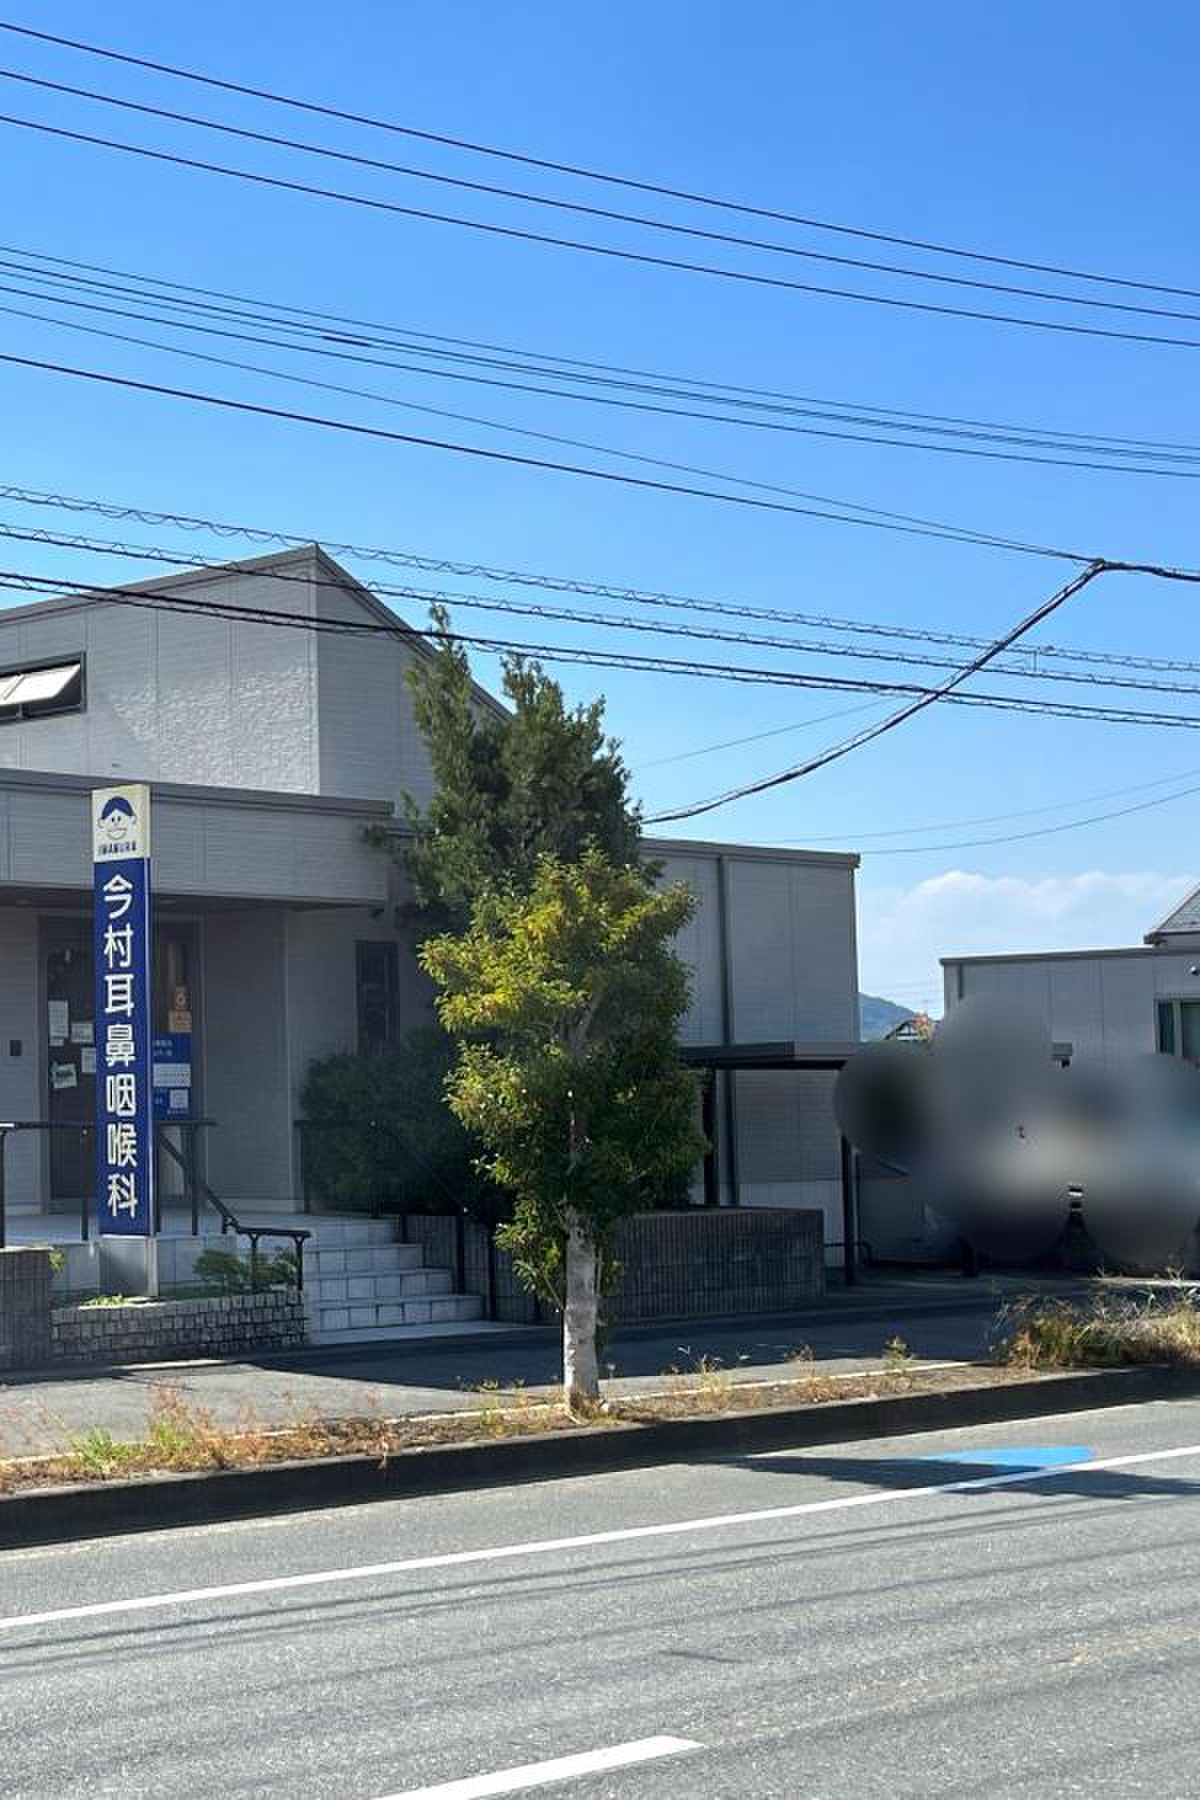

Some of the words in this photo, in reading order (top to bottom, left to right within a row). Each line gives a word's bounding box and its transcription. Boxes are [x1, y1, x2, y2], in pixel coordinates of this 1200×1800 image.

[103, 874, 137, 1219] 今村耳鼻咽喉科
